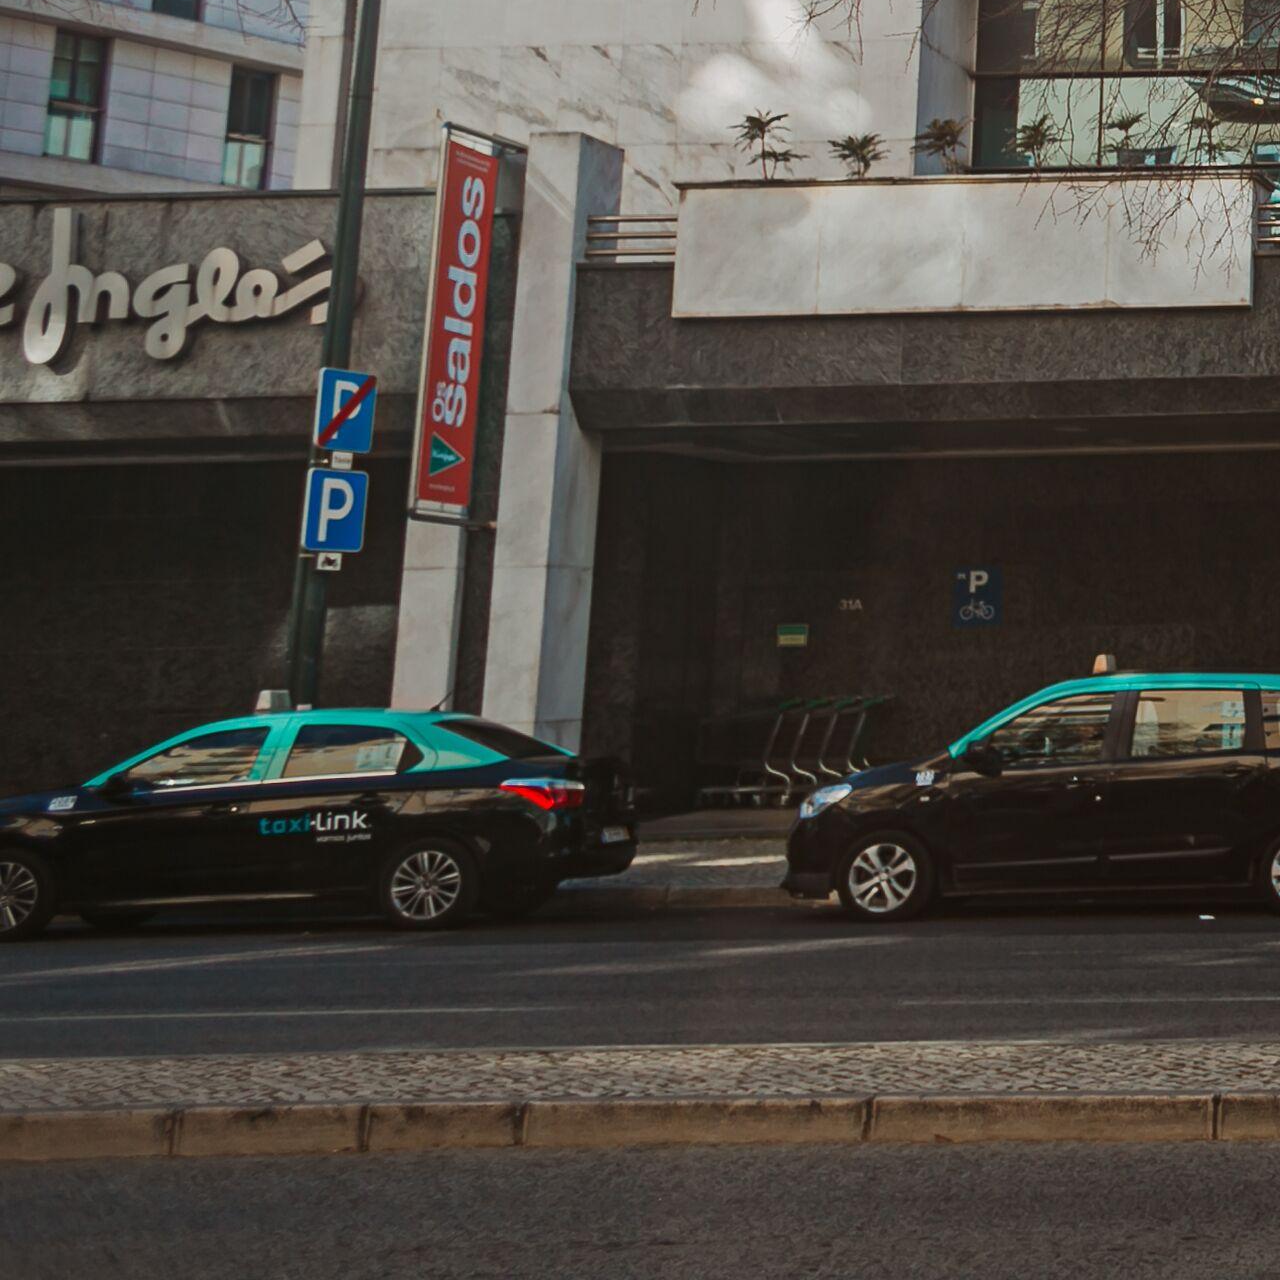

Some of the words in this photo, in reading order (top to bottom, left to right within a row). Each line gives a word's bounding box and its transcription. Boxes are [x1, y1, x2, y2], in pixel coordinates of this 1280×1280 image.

[444, 176, 486, 428] saldos
[332, 380, 362, 440] P
[317, 478, 354, 542] P
[969, 570, 988, 593] P
